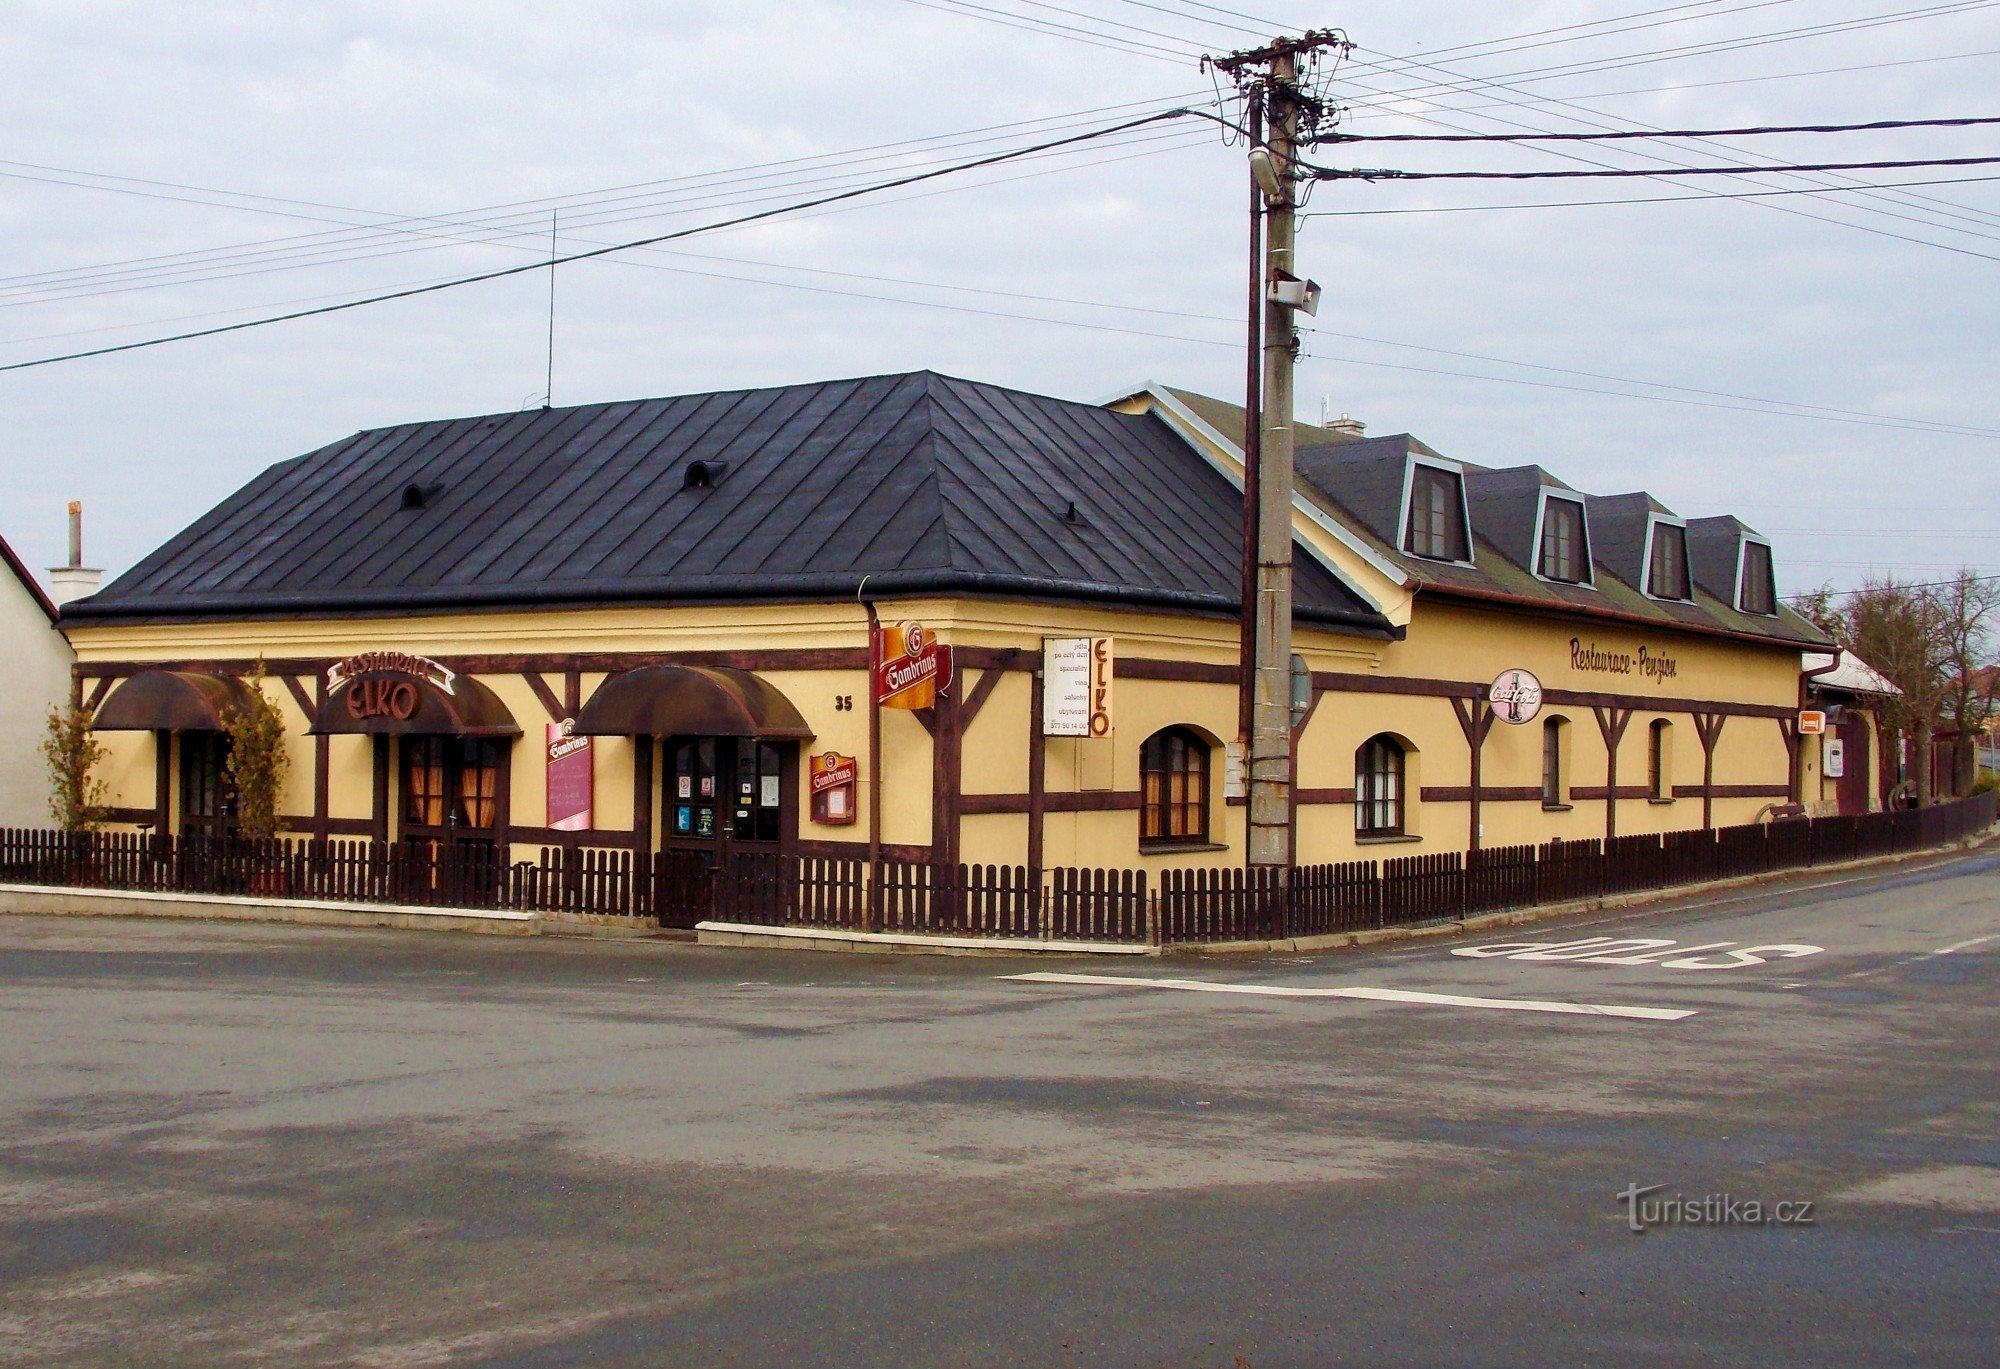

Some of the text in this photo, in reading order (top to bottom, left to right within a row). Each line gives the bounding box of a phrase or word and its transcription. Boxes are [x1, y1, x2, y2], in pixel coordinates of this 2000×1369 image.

[341, 651, 436, 679] RESTAURACE
[886, 653, 936, 690] Gambrinus
[1569, 637, 1631, 675] Restaurace
[1637, 645, 1678, 685] Penzion
[347, 679, 420, 720] ELKO
[834, 695, 853, 712] 35
[1091, 639, 1109, 736] ELKO
[549, 735, 588, 758] Gambrinus
[813, 767, 851, 788] Gambrinus
[1450, 936, 1827, 970] STOP
